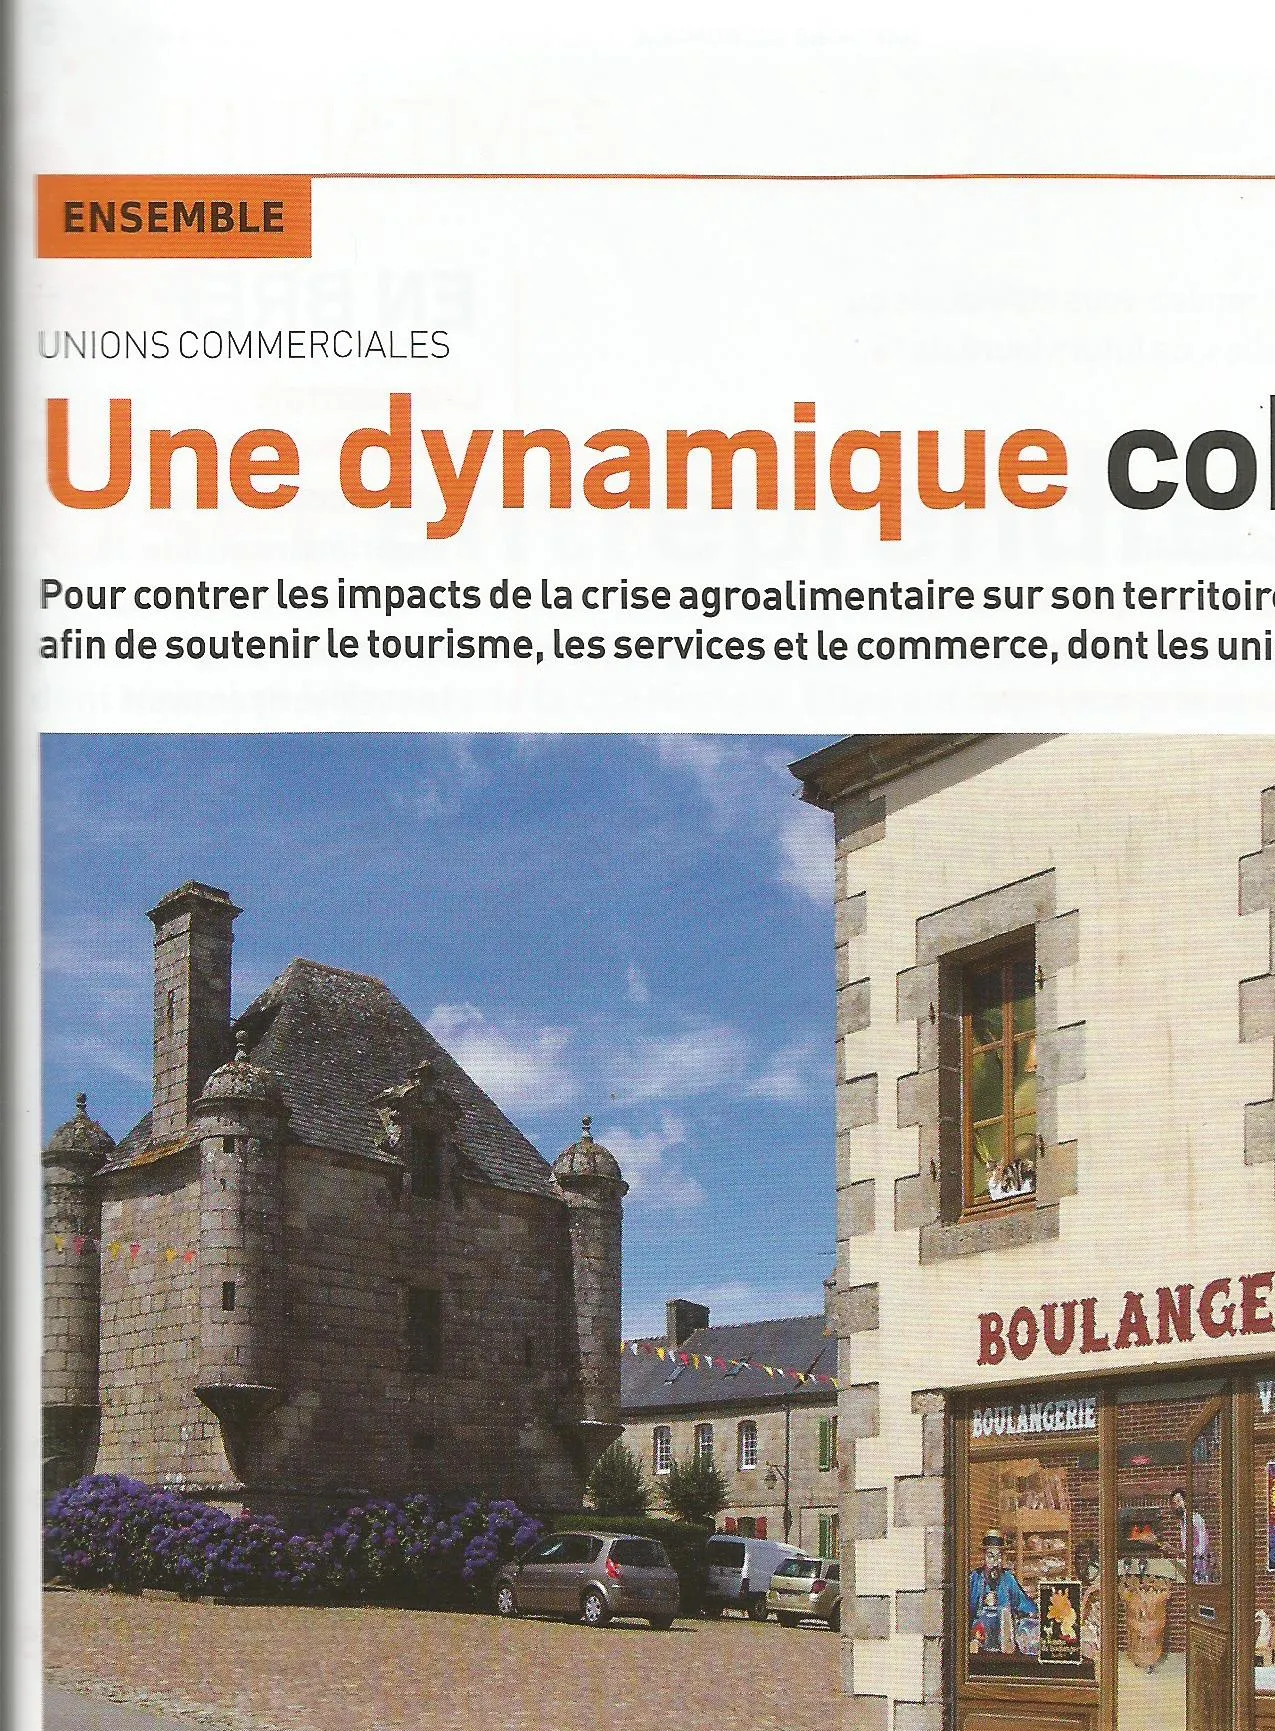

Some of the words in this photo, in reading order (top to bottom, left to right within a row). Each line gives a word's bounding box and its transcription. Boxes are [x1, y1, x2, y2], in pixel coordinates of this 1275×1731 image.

[62, 199, 286, 234] ENSEMBLE
[35, 326, 170, 360] UNIONS
[179, 329, 450, 360] COMMERCIALES
[45, 397, 301, 511] Une
[338, 392, 1069, 543] dynamique
[39, 578, 127, 610] Pour
[133, 580, 270, 610] contrer
[277, 578, 329, 610] les
[337, 577, 482, 617] impacts
[489, 578, 532, 610] de
[541, 578, 573, 610] la
[581, 578, 671, 610] crise
[678, 578, 975, 619] agroalimentaire
[982, 585, 1045, 610] sur
[1050, 586, 1115, 610] son
[38, 628, 106, 660] afin
[114, 628, 158, 660] de
[164, 627, 321, 660] soutenir
[327, 627, 360, 659] le
[366, 627, 544, 666] tourisme,
[553, 628, 606, 660] les
[613, 628, 766, 661] services
[773, 631, 809, 661] et
[817, 629, 849, 661] le
[856, 635, 1059, 666] commerce,
[1067, 628, 1149, 660] dont
[1157, 628, 1209, 661] les
[973, 1397, 1097, 1438] BOULANGERIE
